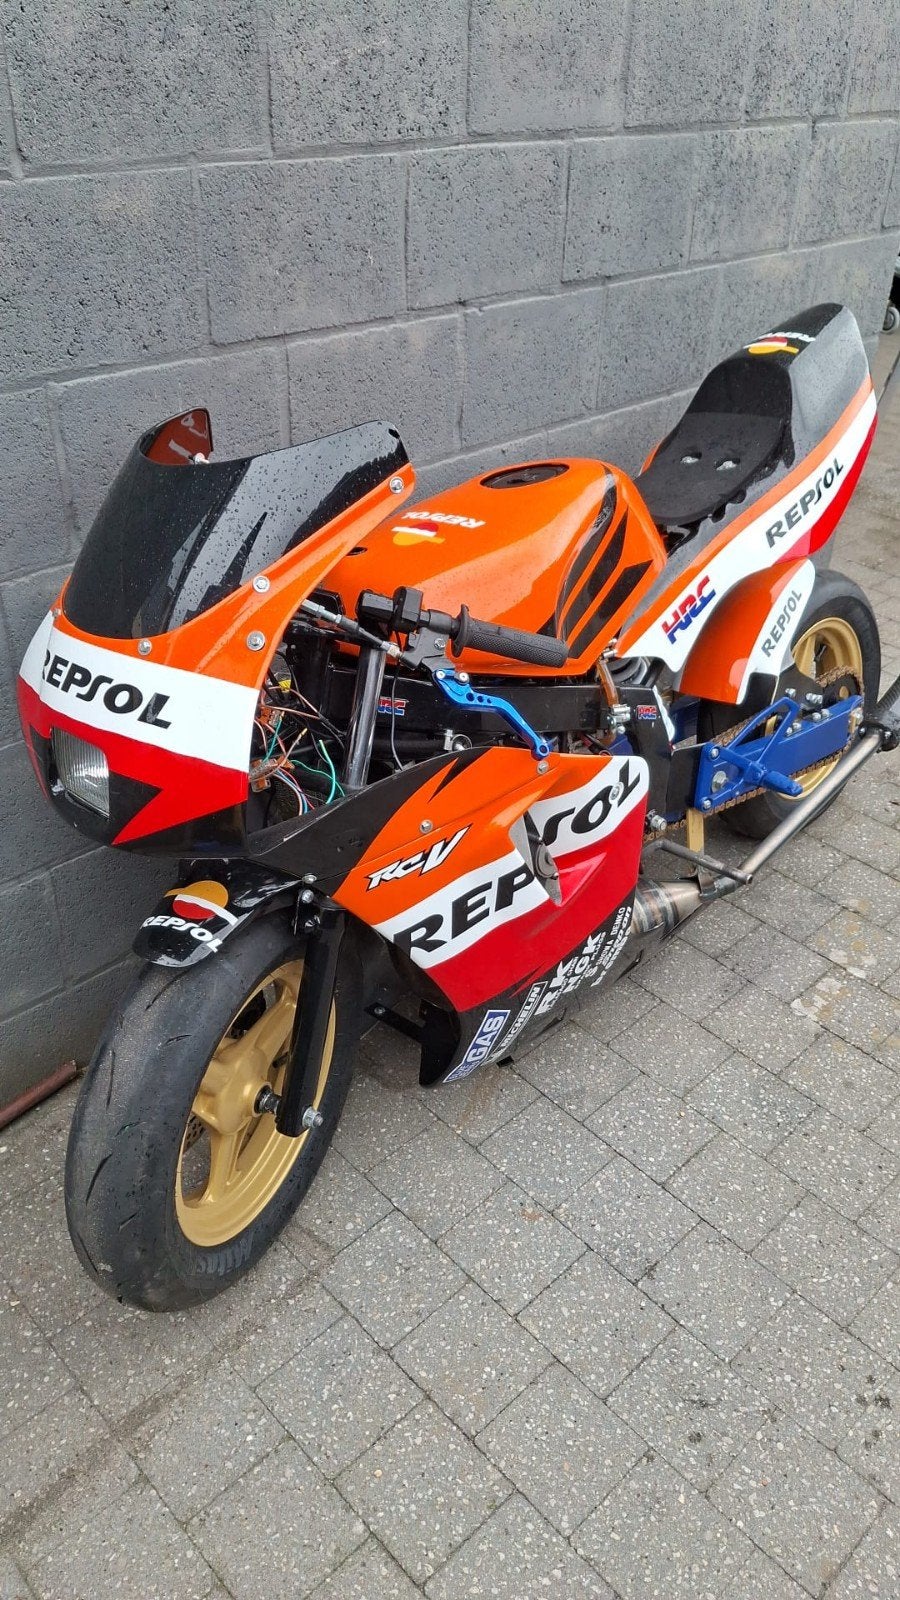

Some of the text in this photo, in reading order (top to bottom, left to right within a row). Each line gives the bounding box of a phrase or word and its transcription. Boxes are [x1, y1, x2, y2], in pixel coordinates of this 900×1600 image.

[765, 457, 844, 548] REPSOL
[661, 575, 716, 645] HRC
[761, 589, 803, 657] REPSOL
[610, 907, 626, 936] DENKO
[534, 957, 575, 1016] RK
[562, 933, 602, 994] NGK
[466, 1015, 505, 1063] GAS
[500, 986, 541, 1048] MICHELIN
